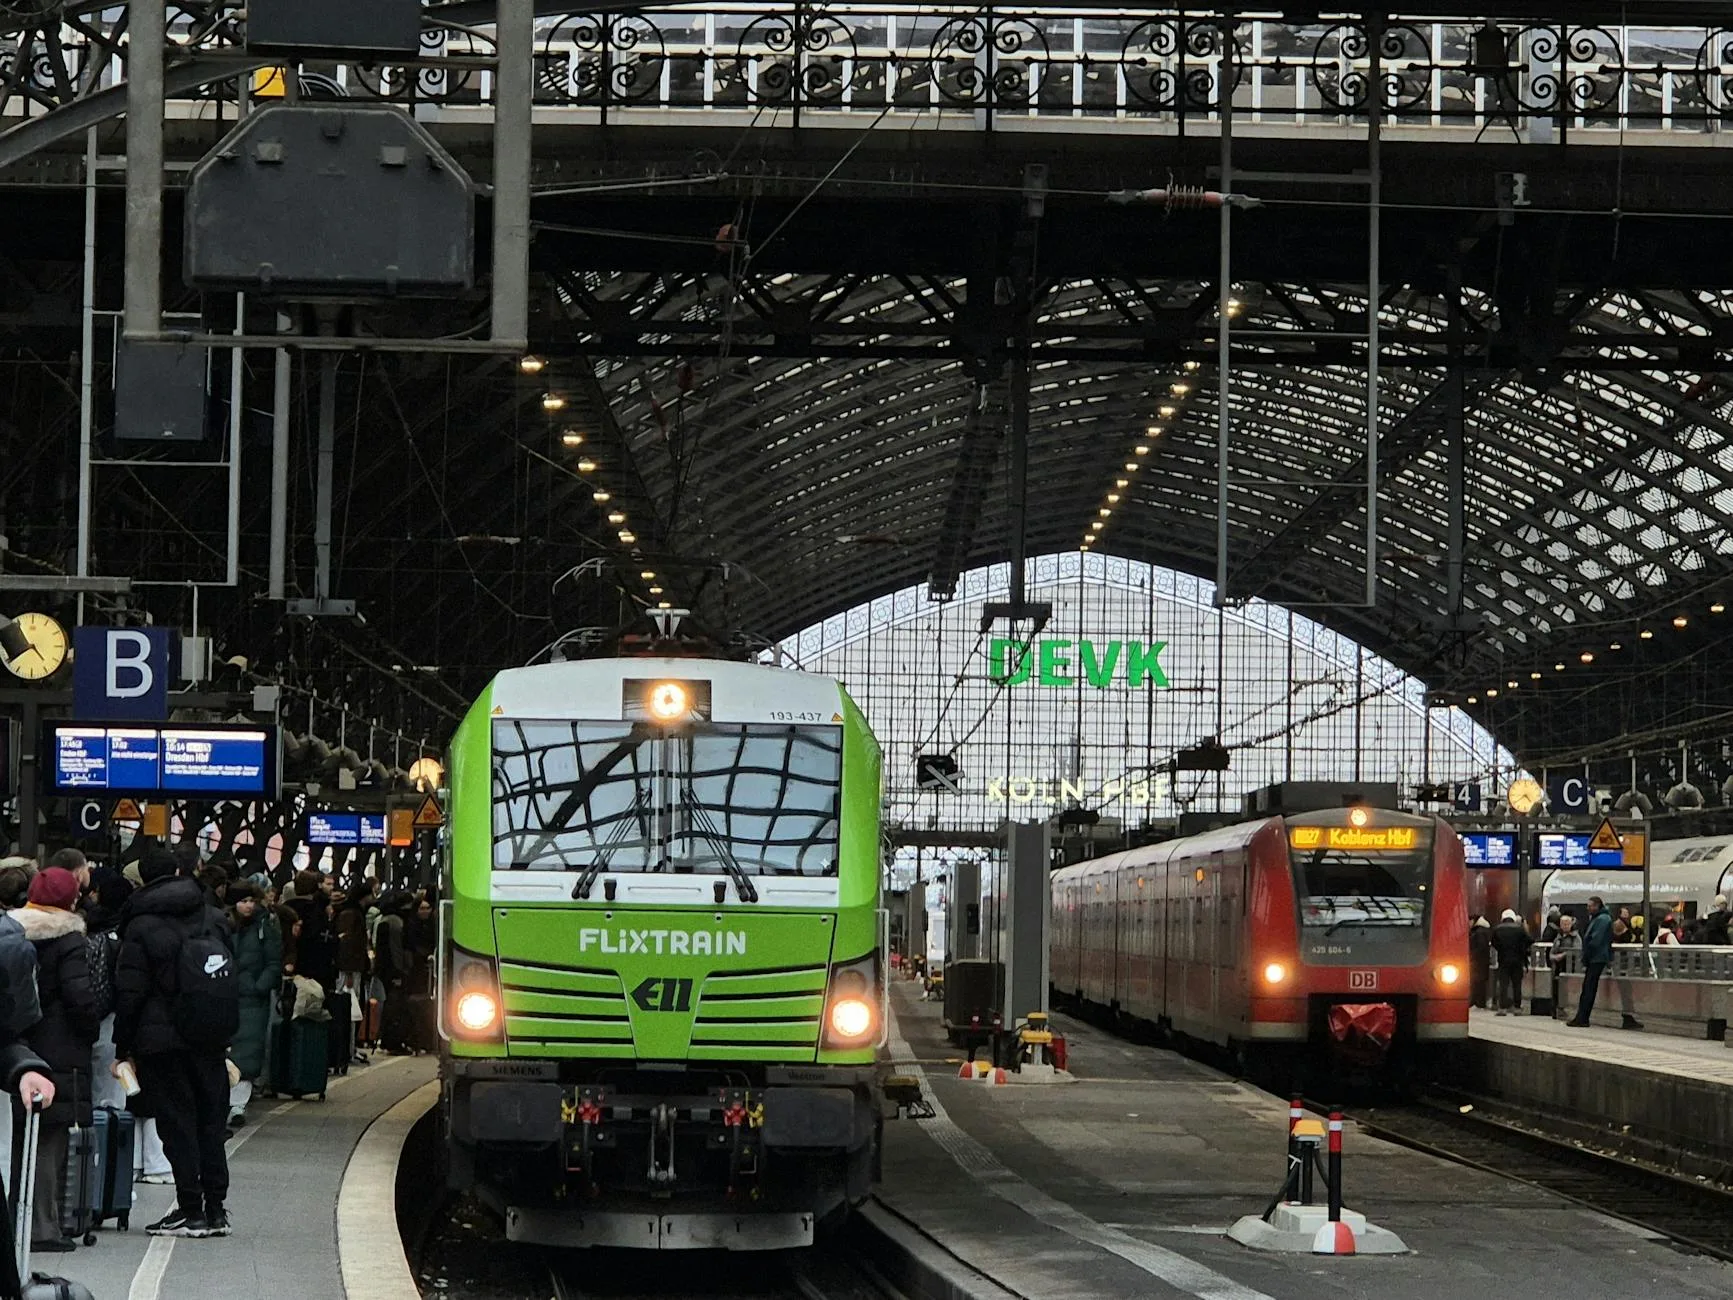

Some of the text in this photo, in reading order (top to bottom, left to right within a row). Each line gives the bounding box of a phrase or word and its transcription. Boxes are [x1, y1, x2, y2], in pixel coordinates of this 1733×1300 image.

[106, 630, 153, 698] B
[989, 638, 1171, 688] DEVK
[769, 711, 822, 721] 193-437
[1457, 784, 1471, 806] 4
[1562, 778, 1583, 807] C
[81, 802, 101, 831] C
[1330, 827, 1386, 846] Koblenz
[1387, 827, 1412, 846] Hbf
[1351, 972, 1375, 988] DB
